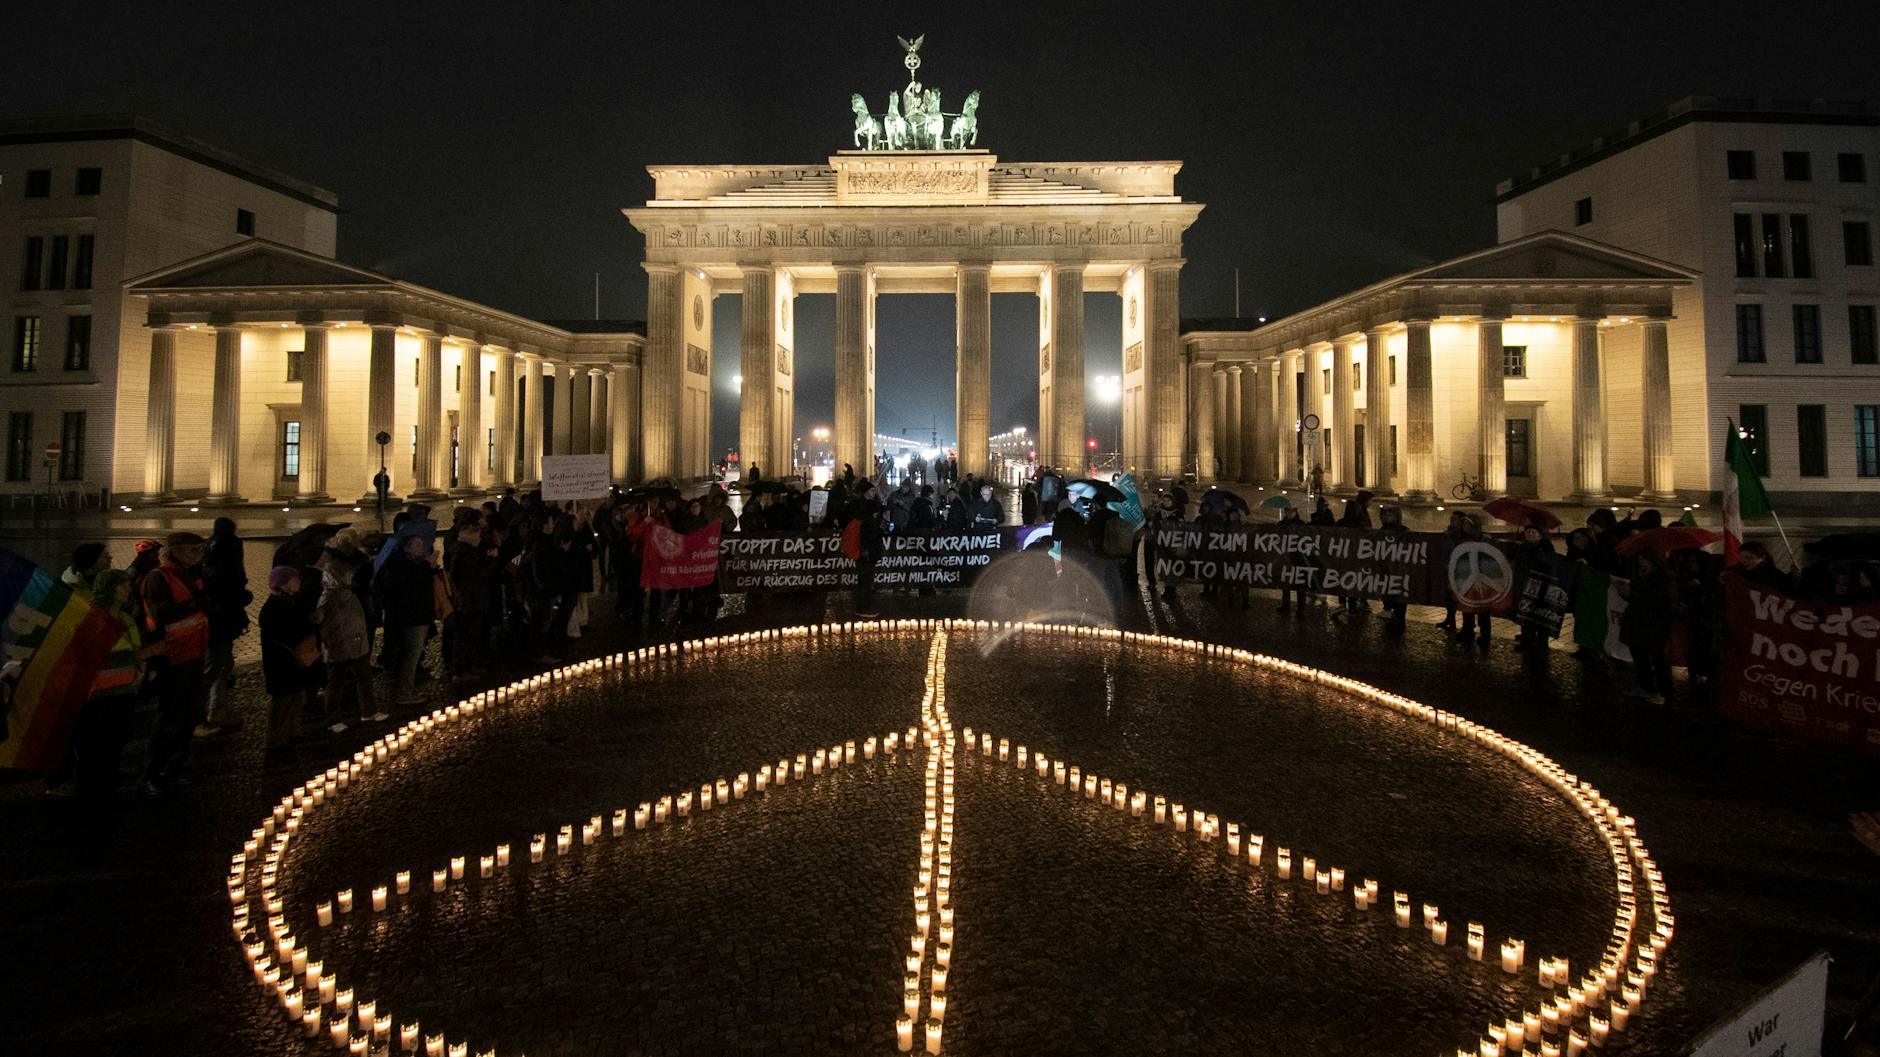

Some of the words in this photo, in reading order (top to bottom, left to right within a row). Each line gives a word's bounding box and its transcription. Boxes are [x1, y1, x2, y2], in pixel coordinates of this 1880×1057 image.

[720, 538, 780, 555] STOPPT
[783, 537, 815, 555] DAS
[820, 533, 843, 554] TÖ
[895, 536, 927, 553] DER
[930, 533, 1001, 552] UKRAINE!
[1157, 530, 1203, 550] NEIN
[1207, 532, 1248, 553] ZUM
[1254, 533, 1320, 556] KRIEG!
[726, 556, 748, 572] FÜR
[875, 555, 964, 568] ERHANDLUNGEN
[966, 554, 991, 566] UND
[1156, 557, 1186, 577] NO
[1190, 560, 1217, 580] TO
[1223, 561, 1273, 585] WAR!
[736, 577, 761, 588] DEN
[763, 571, 815, 588] RÜCKZUG
[816, 574, 838, 586] DES
[908, 569, 961, 584] MILITÄRS!
[1280, 565, 1319, 588] НЕТ
[1322, 567, 1410, 597] ВОЙНЕ!
[1750, 589, 1880, 639] Wede
[1750, 632, 1860, 678] noch
[1744, 664, 1817, 701] Gegen
[1826, 682, 1880, 714] Krie
[1748, 1012, 1780, 1048] War
